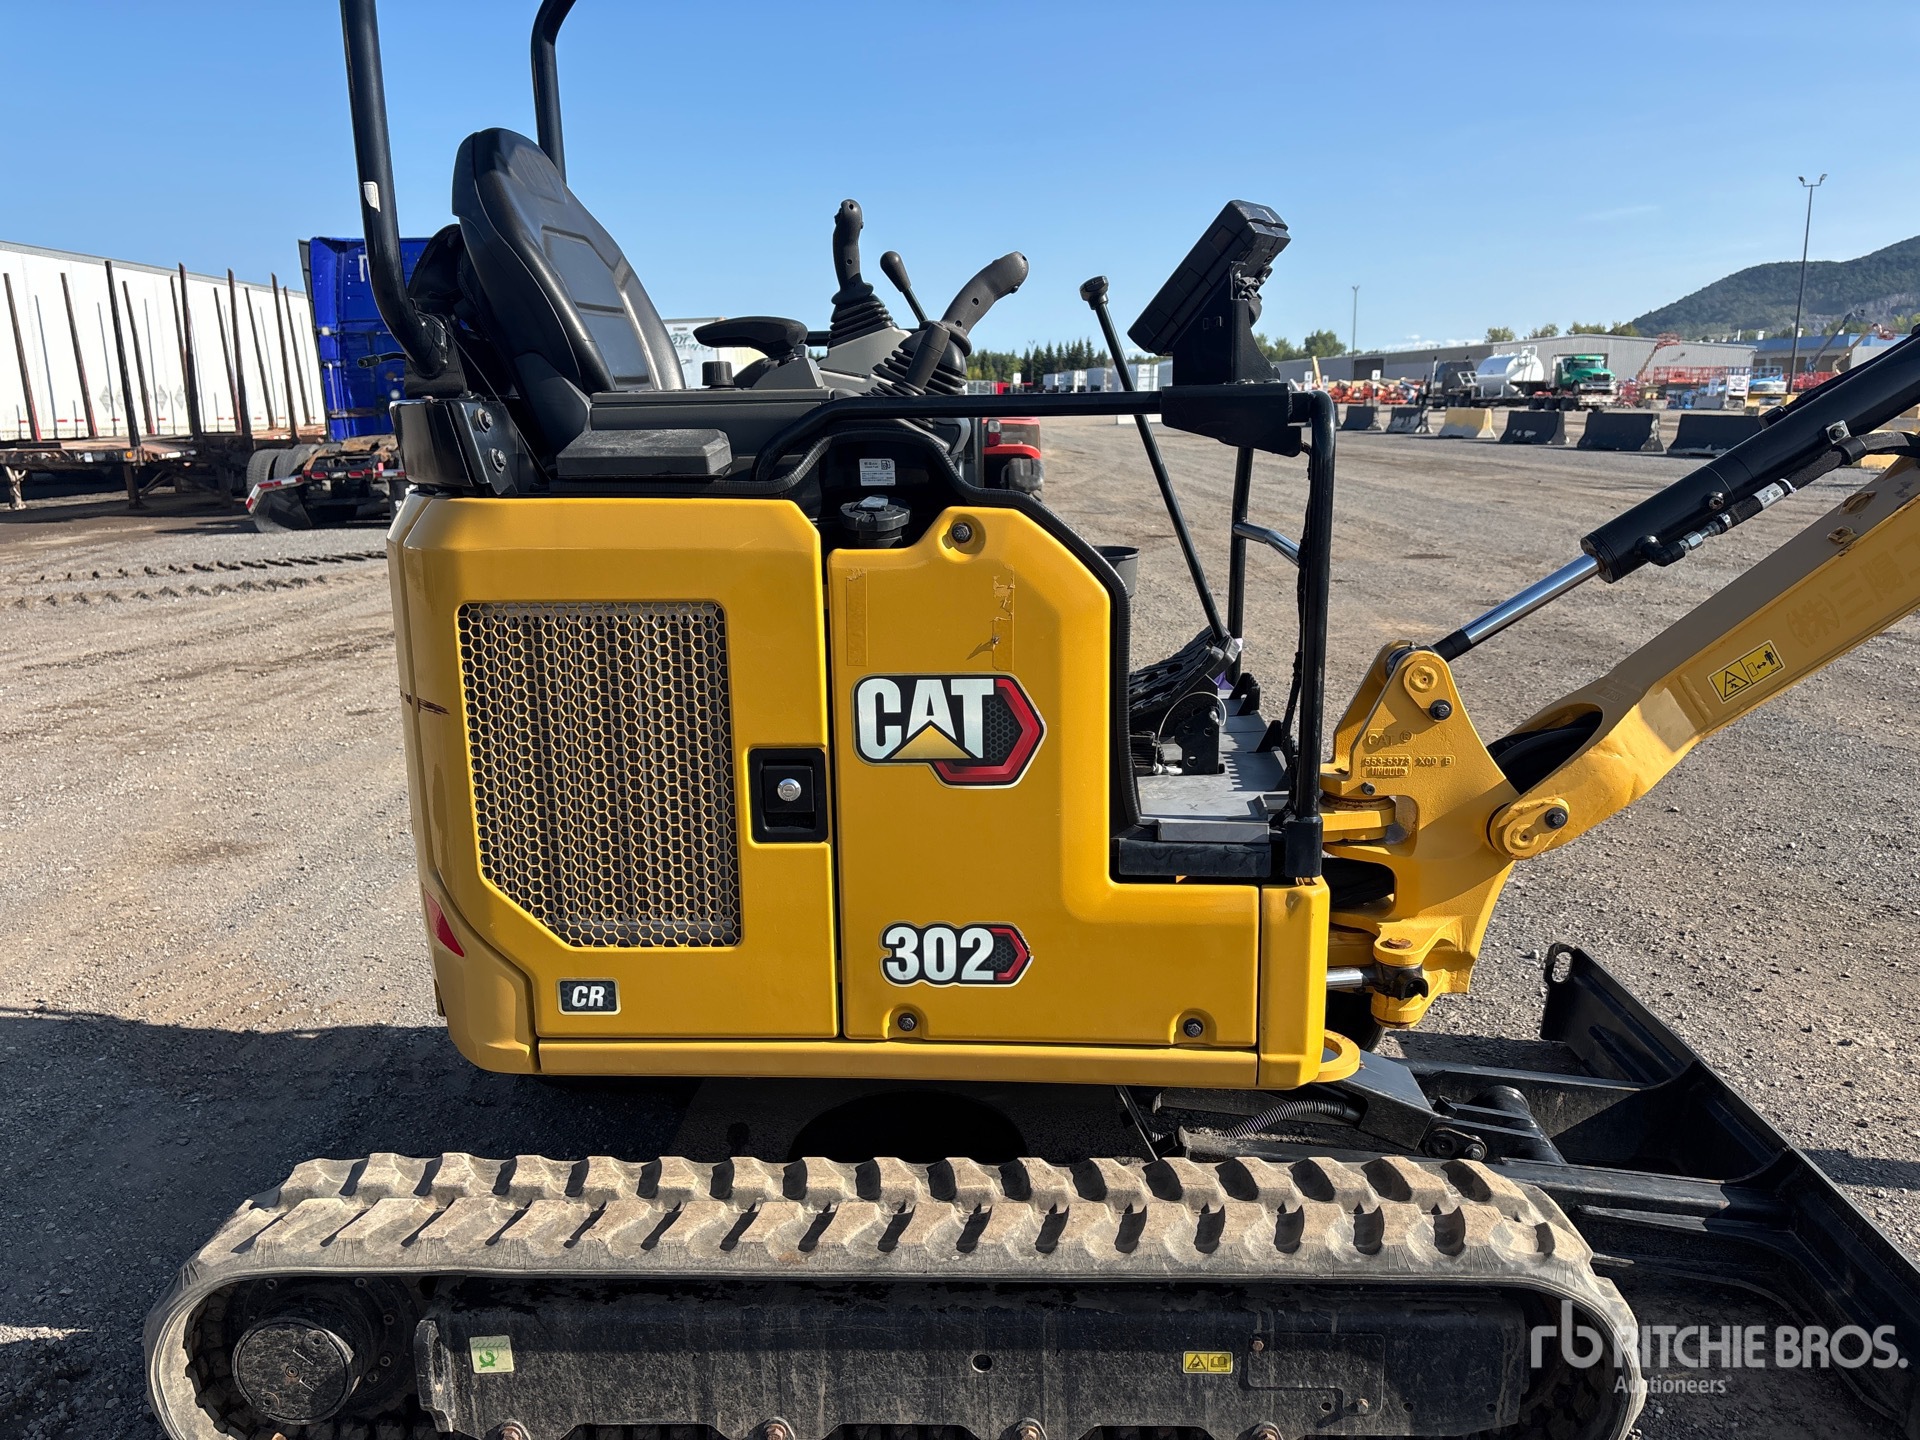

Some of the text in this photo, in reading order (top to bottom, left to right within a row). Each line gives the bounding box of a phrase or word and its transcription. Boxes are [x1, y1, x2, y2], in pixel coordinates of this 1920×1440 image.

[857, 678, 994, 760] CAT
[1368, 733, 1394, 746] CAT
[885, 926, 995, 981] 302
[571, 985, 605, 1007] CR
